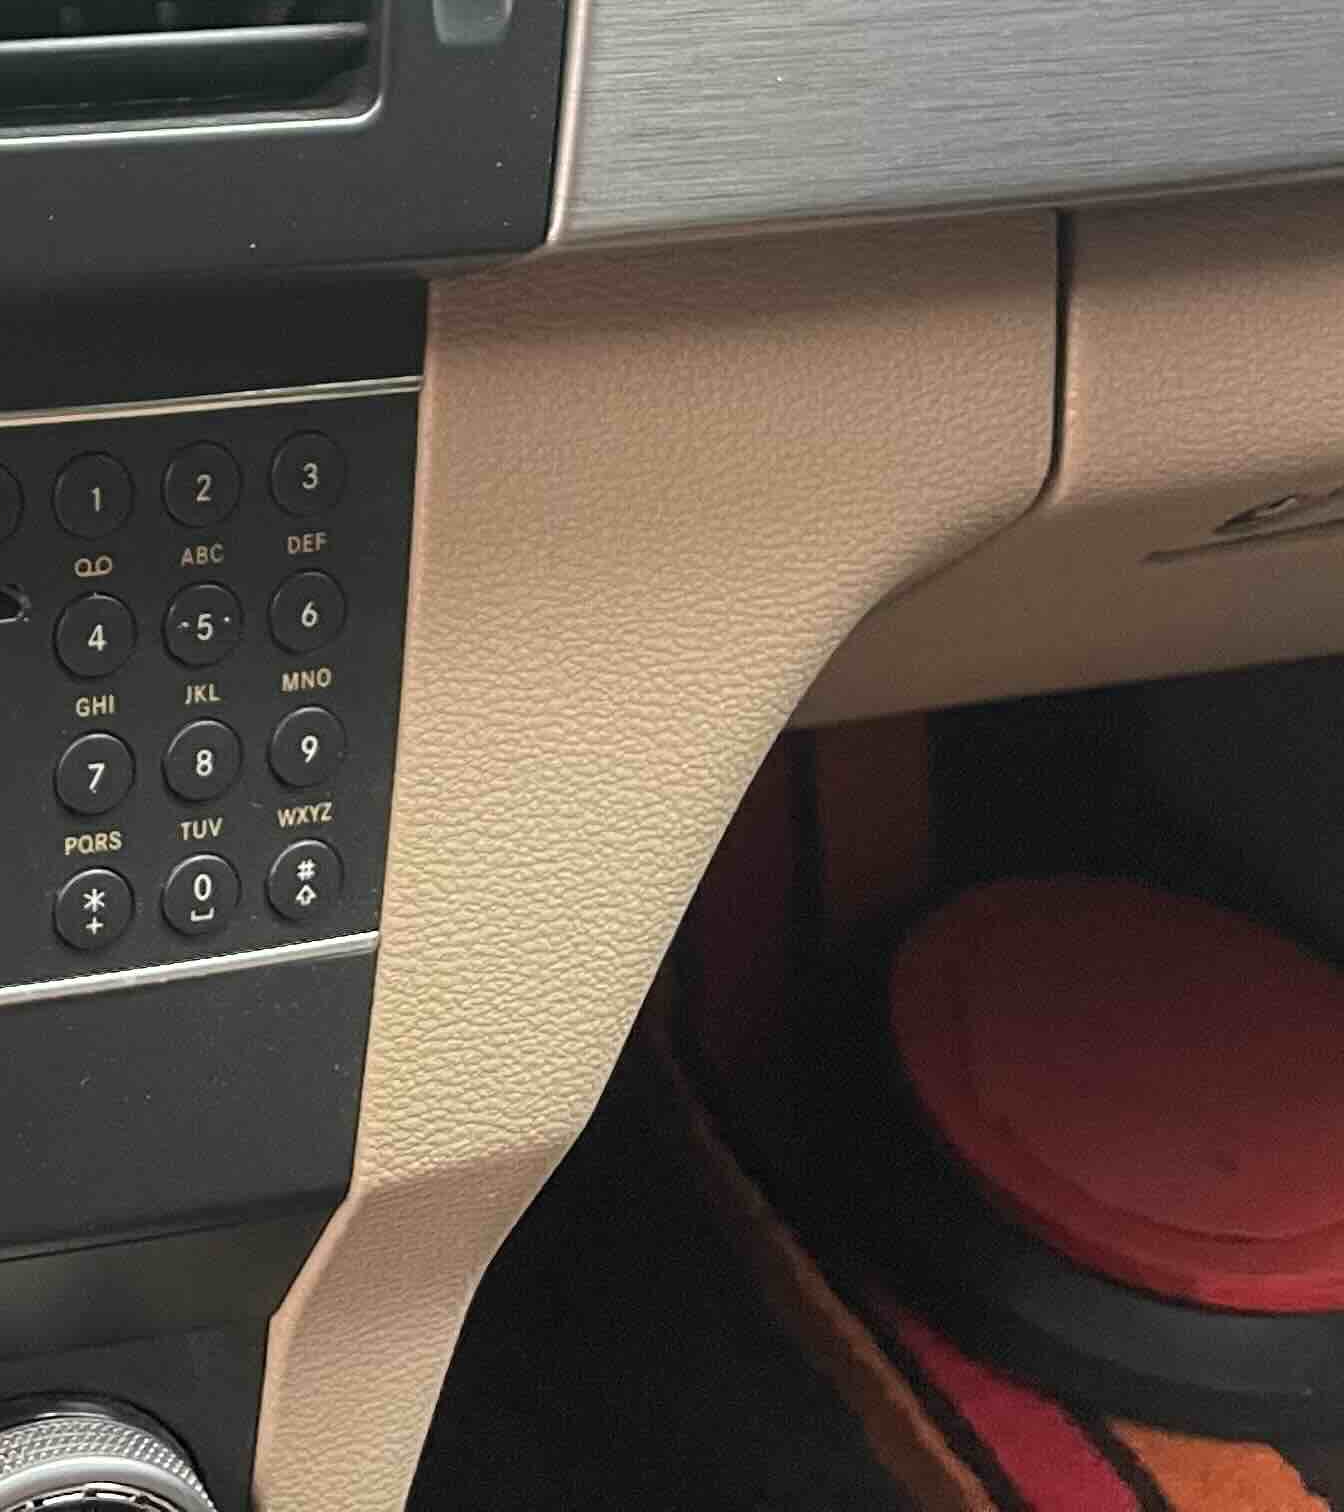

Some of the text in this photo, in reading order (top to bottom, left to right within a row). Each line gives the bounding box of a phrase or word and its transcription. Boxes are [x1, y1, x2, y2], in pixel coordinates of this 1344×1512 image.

[196, 475, 212, 502] 2
[302, 463, 319, 489] 3
[91, 487, 102, 512] 1
[180, 544, 224, 567] ABC
[287, 533, 328, 555] DEF
[301, 601, 318, 627] 6
[87, 624, 105, 650] 4
[196, 614, 213, 641] 5
[282, 668, 332, 691] MNO
[75, 694, 115, 717] GHI
[185, 684, 221, 705] JKL
[301, 736, 318, 763] 9
[196, 750, 213, 777] 8
[87, 764, 105, 789] 7
[277, 803, 333, 828] WXYZ
[181, 819, 224, 841] TUV
[64, 831, 122, 856] PQRS
[194, 873, 212, 901] 0
